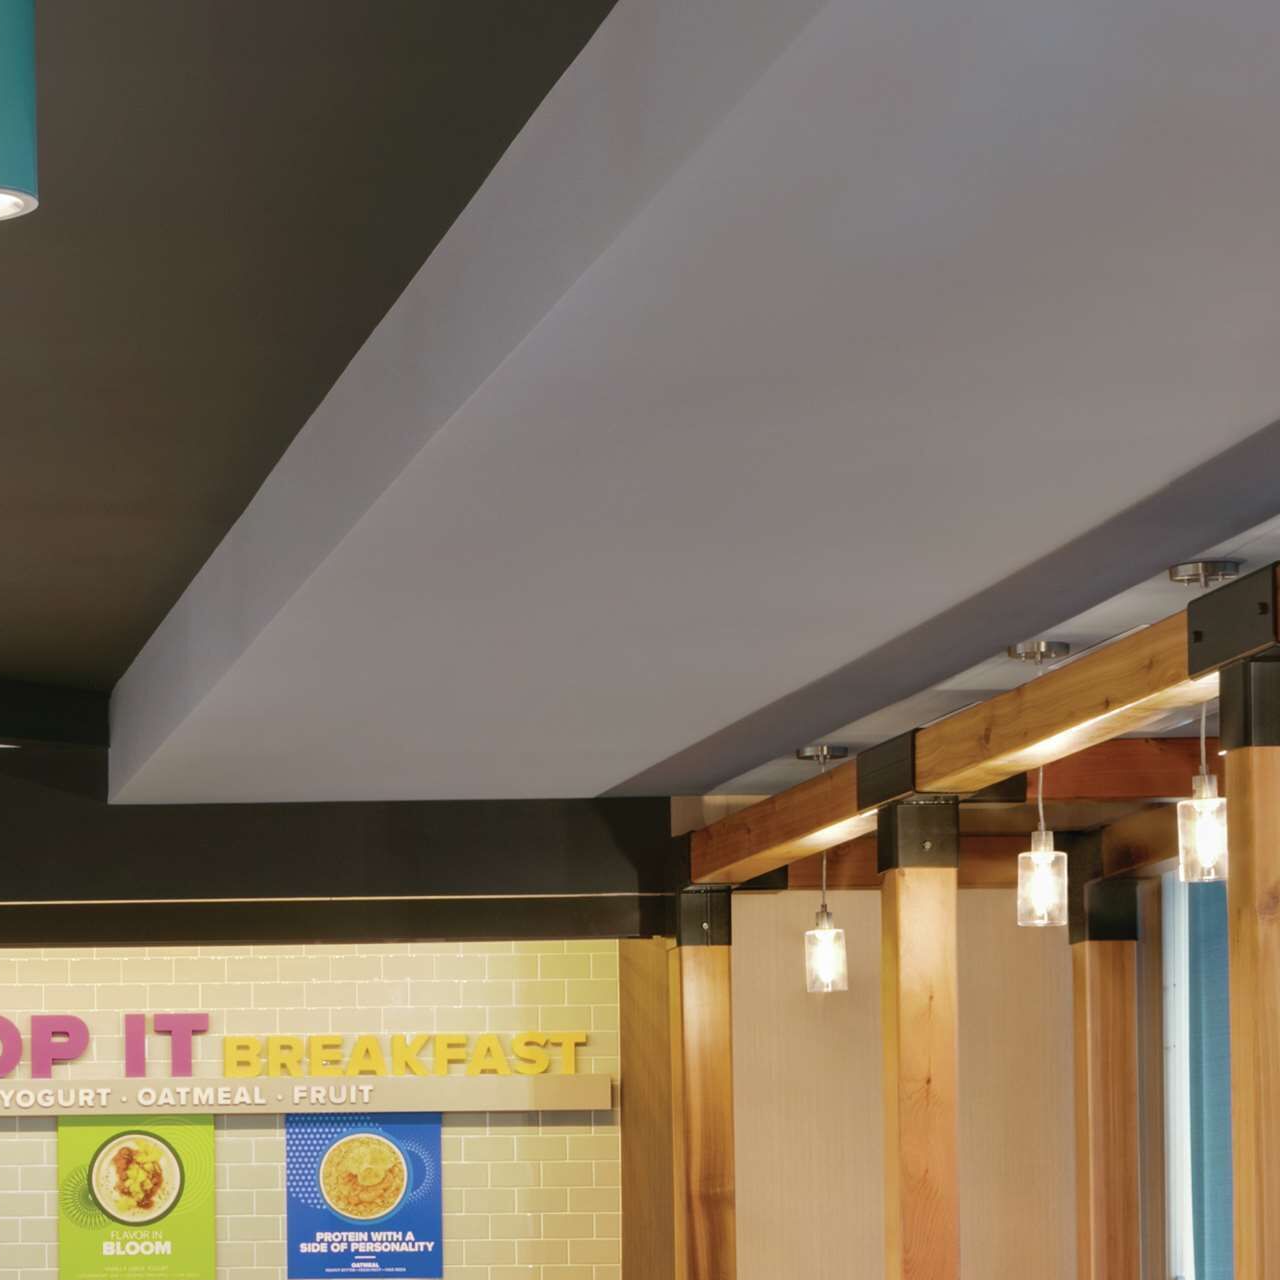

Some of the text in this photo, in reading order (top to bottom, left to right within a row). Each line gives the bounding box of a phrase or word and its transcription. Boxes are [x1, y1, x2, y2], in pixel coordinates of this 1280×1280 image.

[124, 1013, 209, 1078] IT
[223, 1031, 588, 1078] BREAKFAST
[137, 1085, 267, 1107] OATMEAL
[292, 1084, 374, 1105] FRUIT
[110, 1230, 163, 1240] FLAVOR IN
[316, 1231, 415, 1242] PROTEIN WITH A
[102, 1240, 172, 1256] BLOOM
[299, 1241, 434, 1253] SIDE OF PERSONALITY
